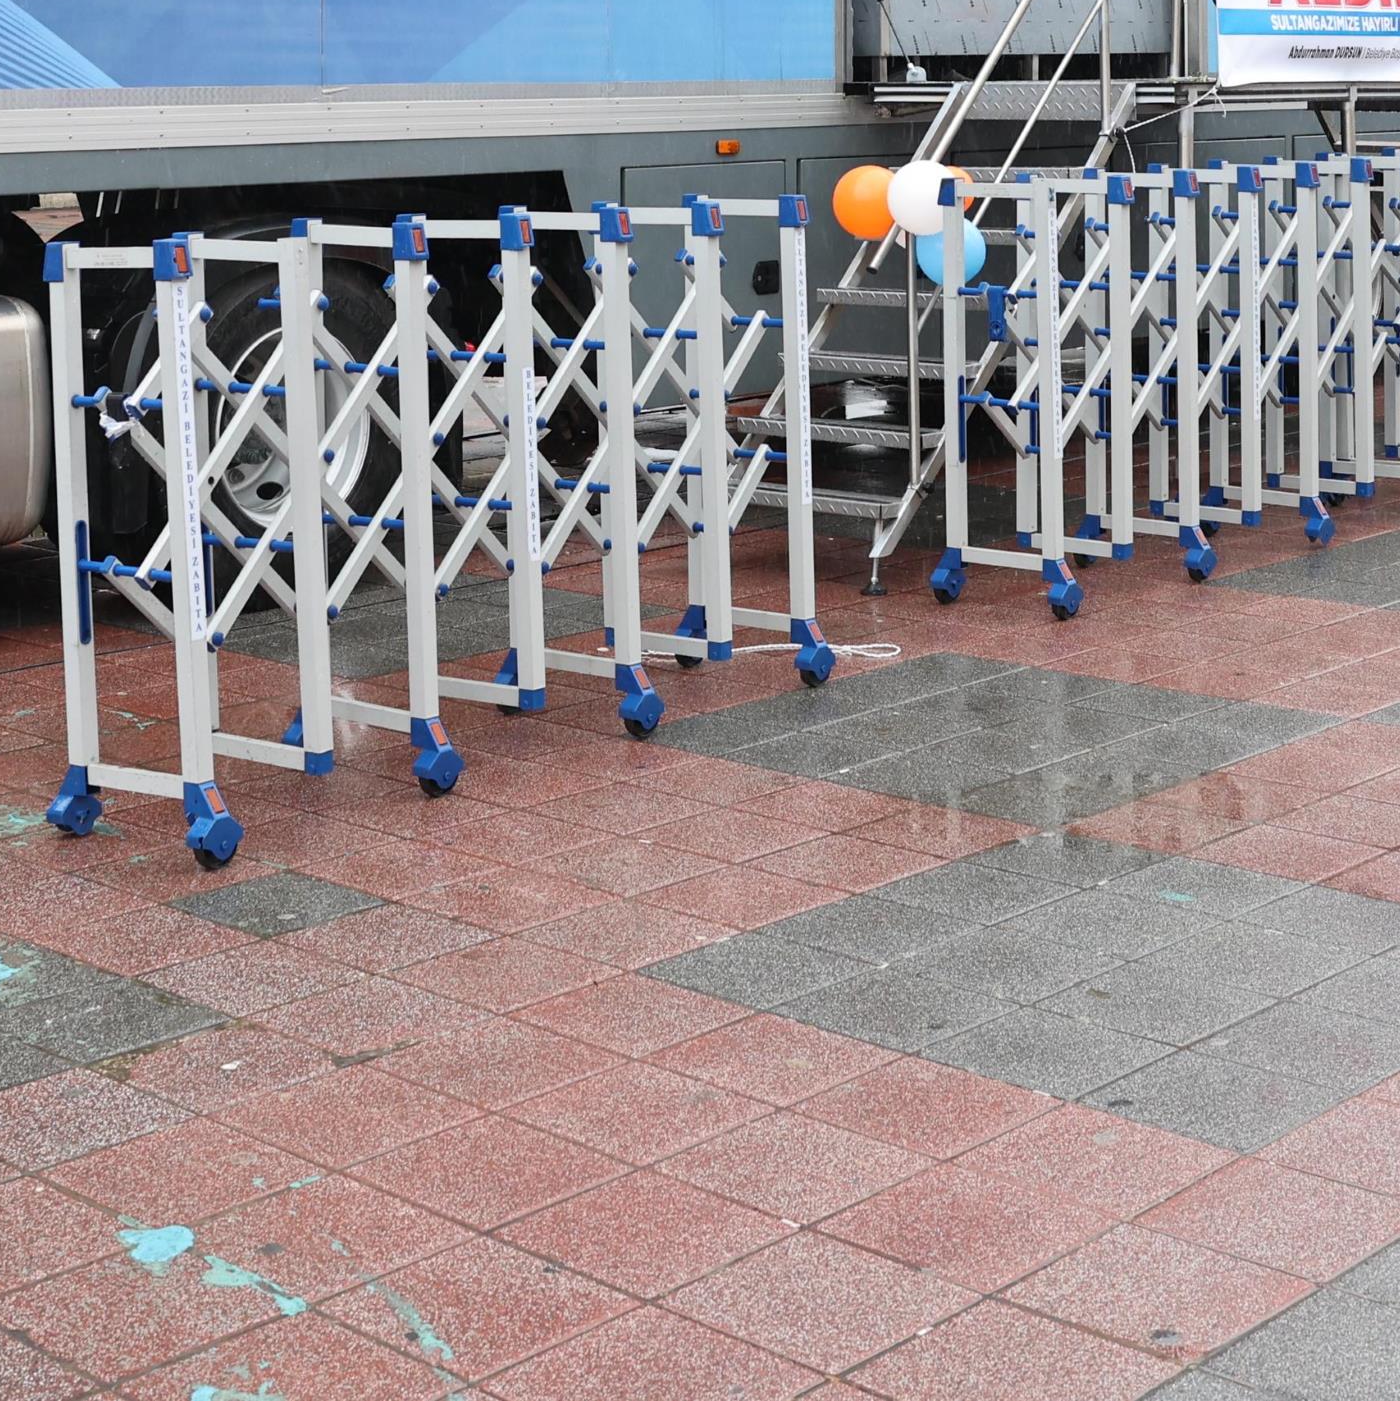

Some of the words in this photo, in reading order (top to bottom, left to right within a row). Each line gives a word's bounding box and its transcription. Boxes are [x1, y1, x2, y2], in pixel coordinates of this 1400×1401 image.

[1361, 15, 1398, 32] HAYIRLI
[1288, 46, 1333, 59] Abdurrahman
[1334, 46, 1363, 59] DURSUN
[176, 285, 190, 414] SULTANGAZİ
[184, 421, 197, 550] BELEDİYESİ
[191, 557, 203, 633] ZABITA
